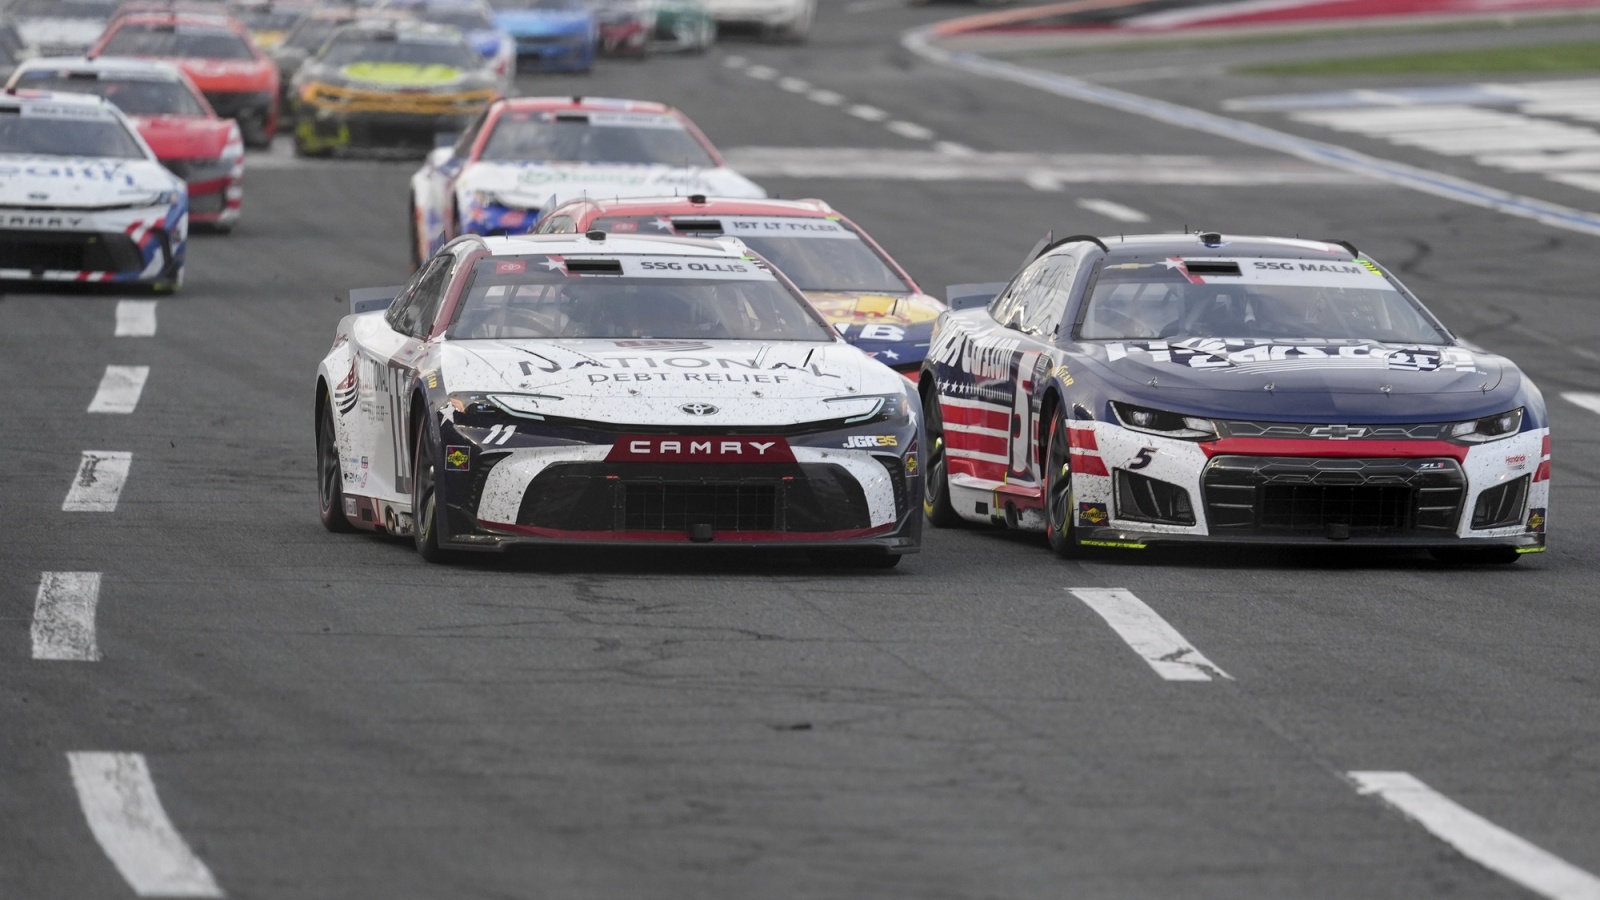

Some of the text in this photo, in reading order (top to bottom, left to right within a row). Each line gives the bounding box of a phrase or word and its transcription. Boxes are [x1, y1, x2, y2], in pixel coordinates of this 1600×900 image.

[0, 216, 82, 226] AMRY
[731, 221, 840, 233] 1ST LT TYLER
[640, 261, 749, 273] SSG OLLIS
[1252, 261, 1363, 275] SSG MALM
[517, 357, 841, 379] NATIONAL
[587, 372, 790, 384] DEBT RELIEF
[481, 424, 518, 445] 11
[629, 440, 776, 454] CAMRY
[1128, 447, 1159, 470] 5
